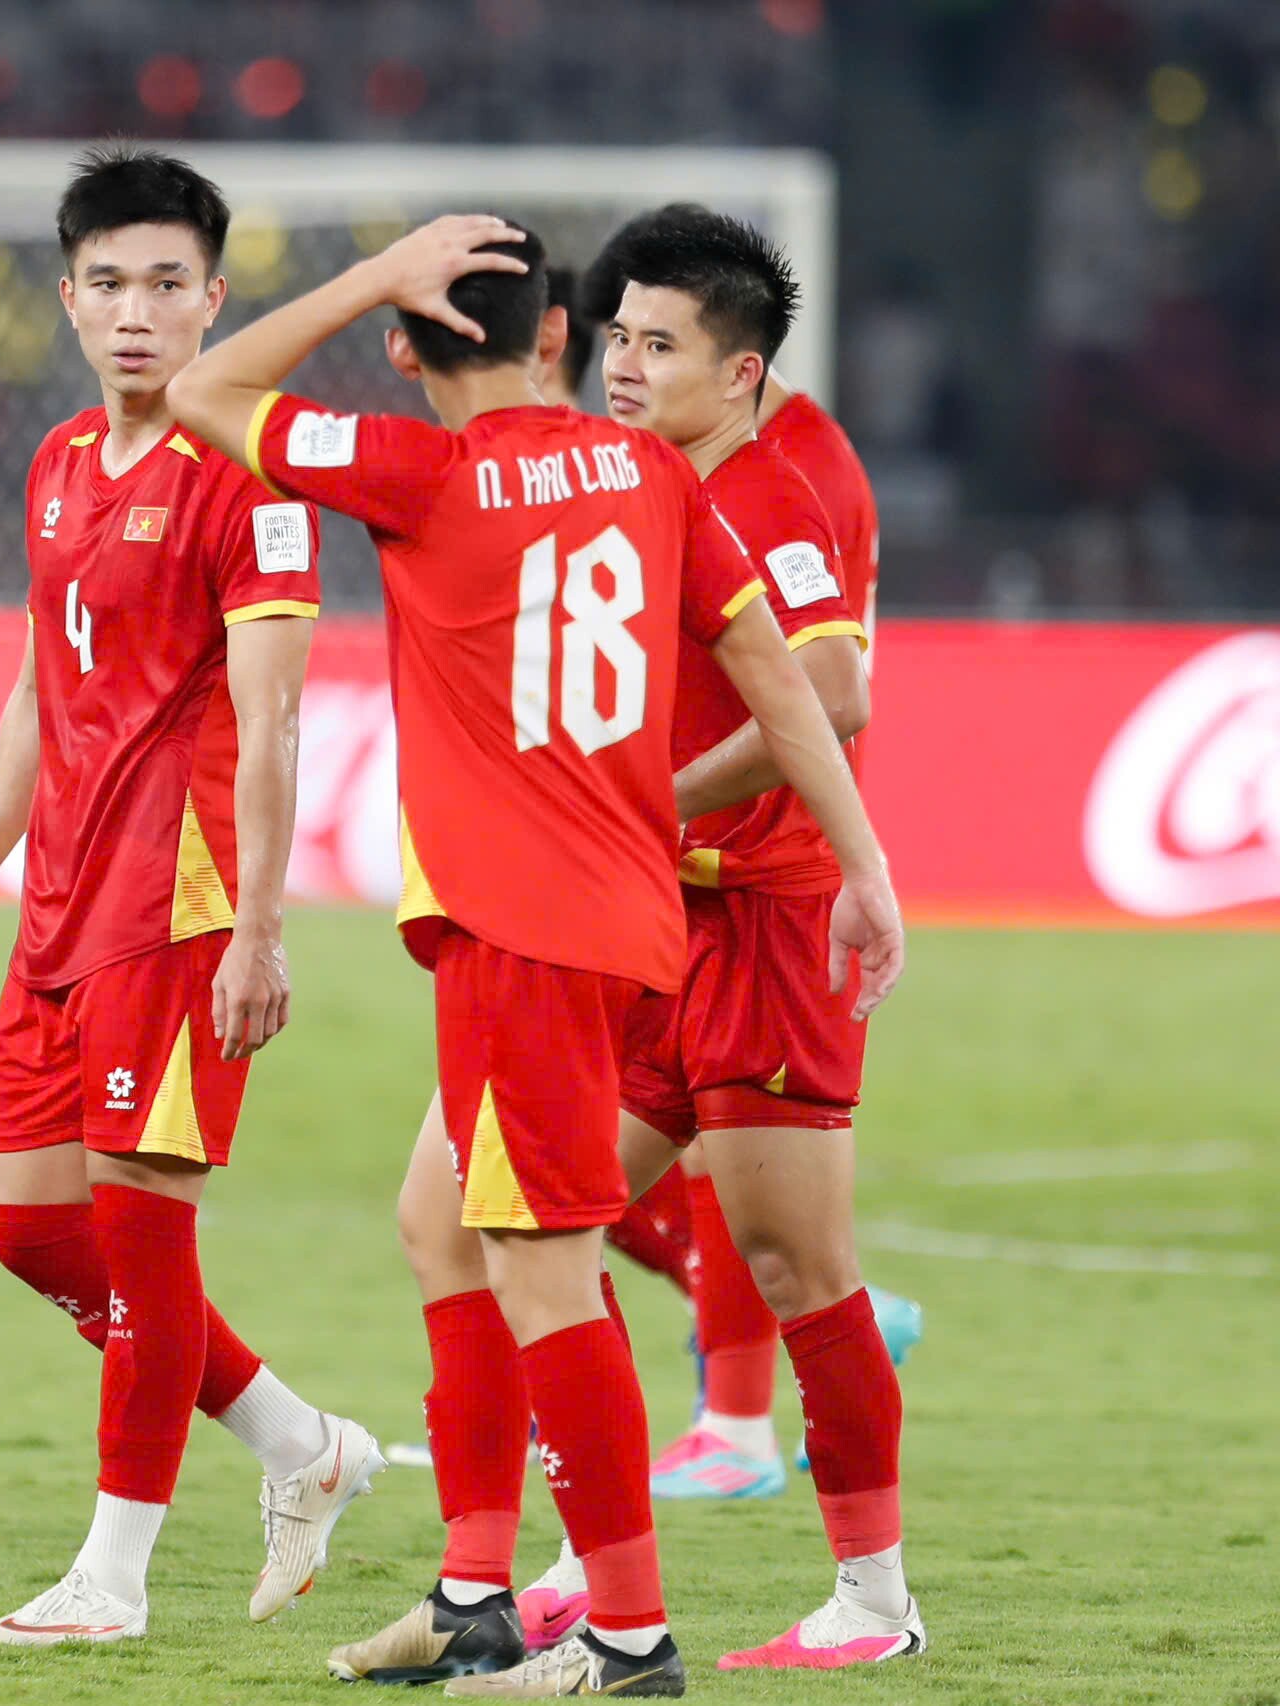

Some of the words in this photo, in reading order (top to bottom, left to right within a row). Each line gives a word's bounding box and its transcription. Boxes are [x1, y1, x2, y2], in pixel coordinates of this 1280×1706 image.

[516, 451, 573, 507] HAI
[570, 441, 641, 495] LONG
[264, 514, 298, 527] FOOTBALL
[265, 525, 300, 540] UNITES
[64, 578, 95, 675] 4
[511, 523, 648, 759] 18
